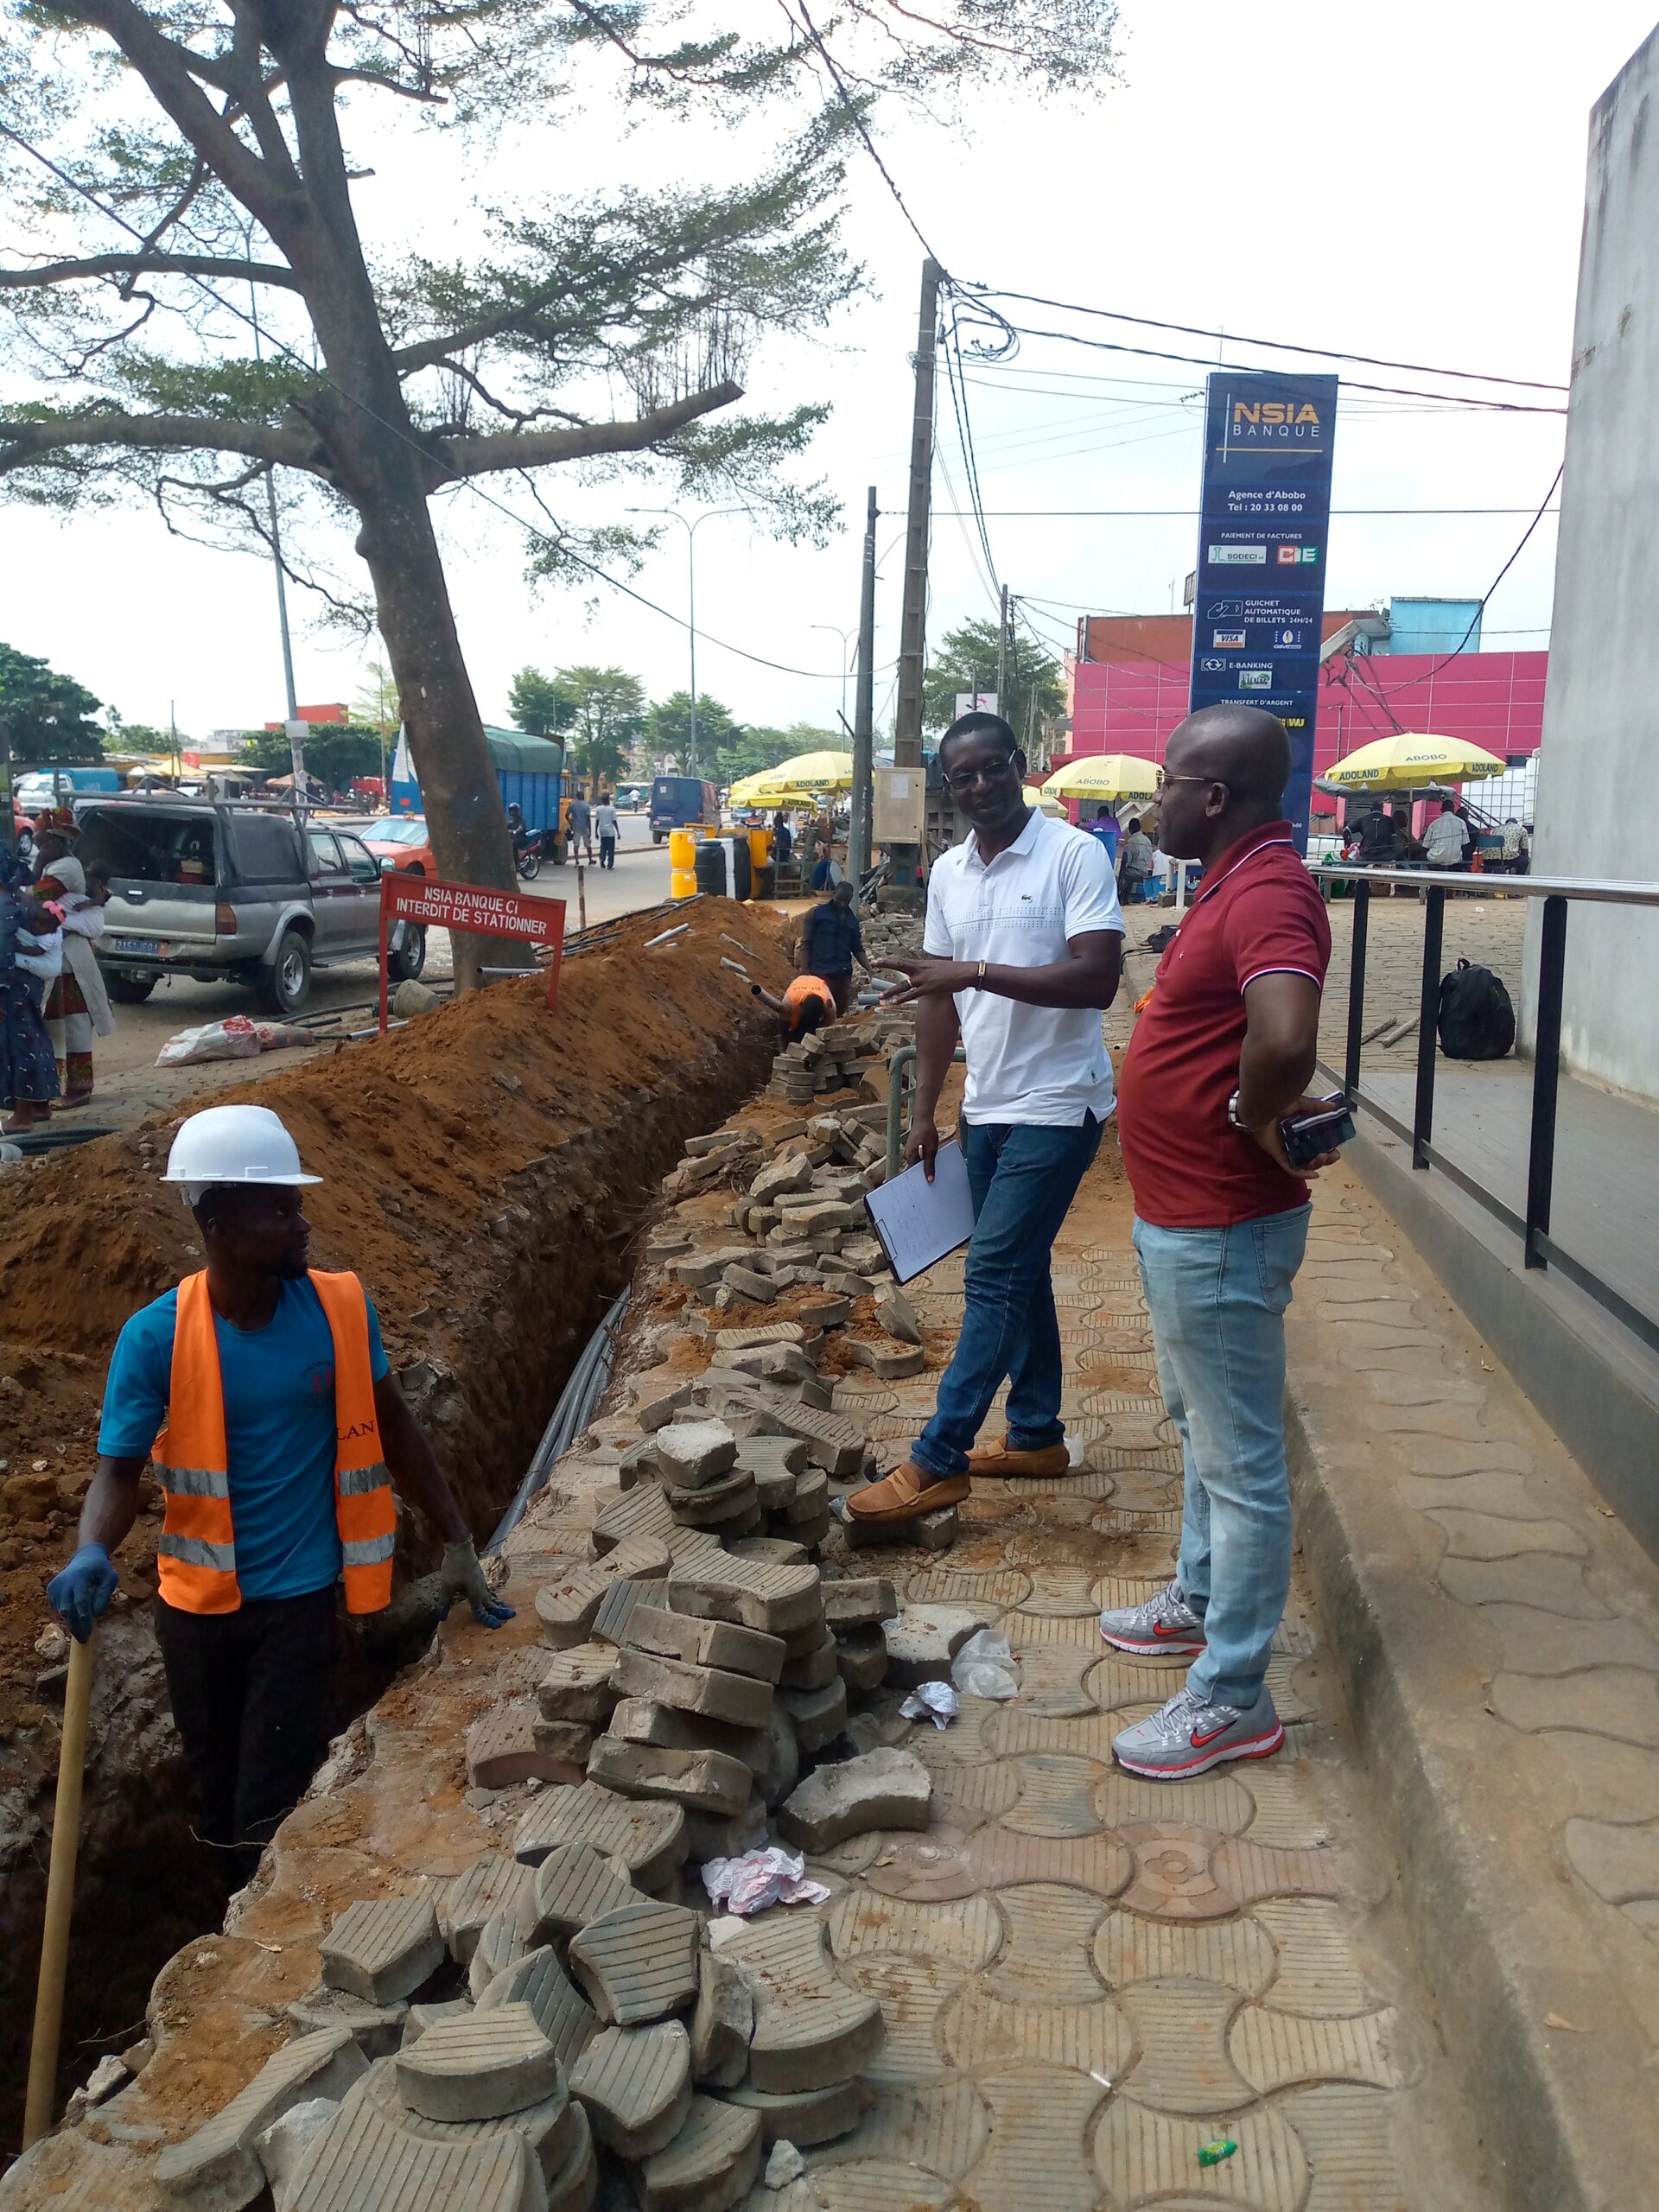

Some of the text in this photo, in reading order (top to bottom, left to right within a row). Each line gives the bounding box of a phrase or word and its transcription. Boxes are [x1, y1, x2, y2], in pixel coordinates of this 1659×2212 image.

[1234, 402, 1319, 424] NSIA
[1233, 425, 1319, 437] BANQUE
[1228, 491, 1306, 500] Agence d'Abobo
[1228, 503, 1243, 512] Tel
[1405, 753, 1446, 762] ABOBO
[1472, 763, 1498, 772] ADOLAND
[1339, 769, 1379, 780] ADOLAND
[795, 779, 830, 788] ADOLAND
[424, 887, 453, 904] NSIA
[454, 891, 504, 912] BANQUE
[397, 898, 547, 936] INTERDIT DE STATIONNER
